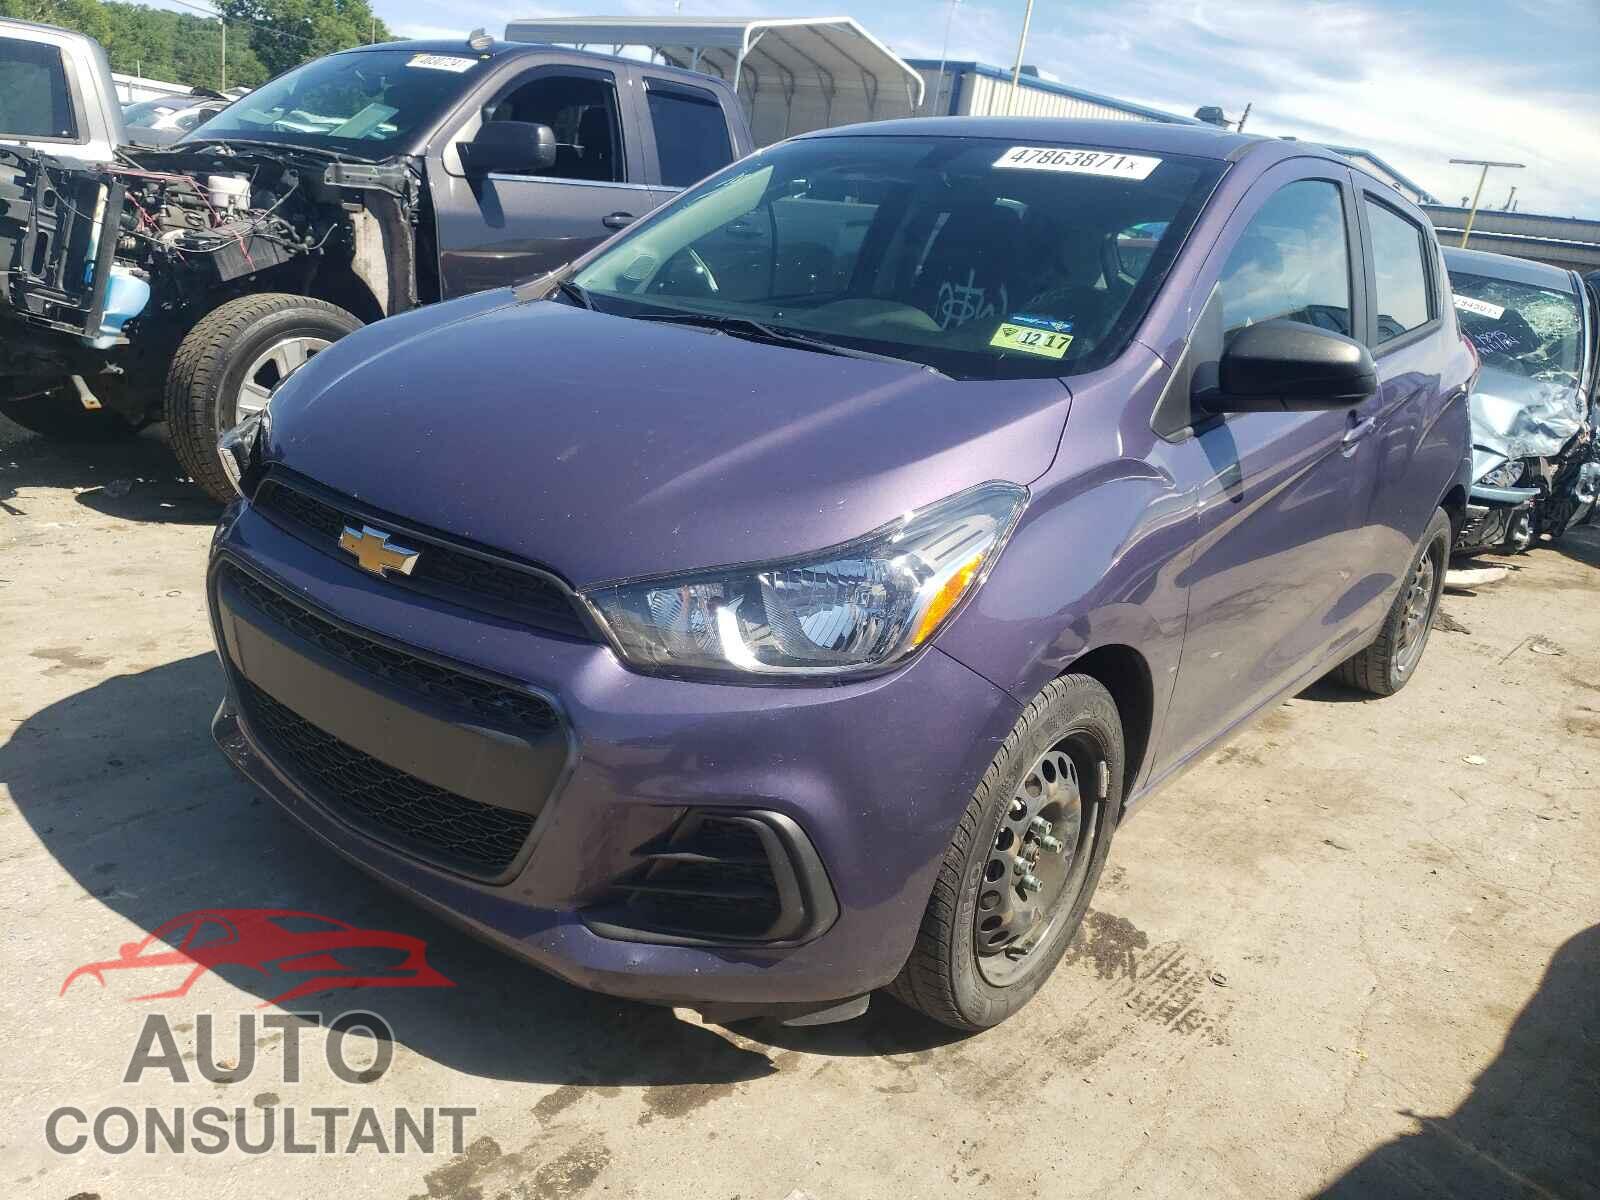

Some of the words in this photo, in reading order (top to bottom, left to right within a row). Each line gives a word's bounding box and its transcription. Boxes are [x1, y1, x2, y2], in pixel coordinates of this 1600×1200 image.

[1009, 149, 1127, 170] 47863871
[1018, 331, 1042, 346] 12
[1044, 334, 1071, 350] 17
